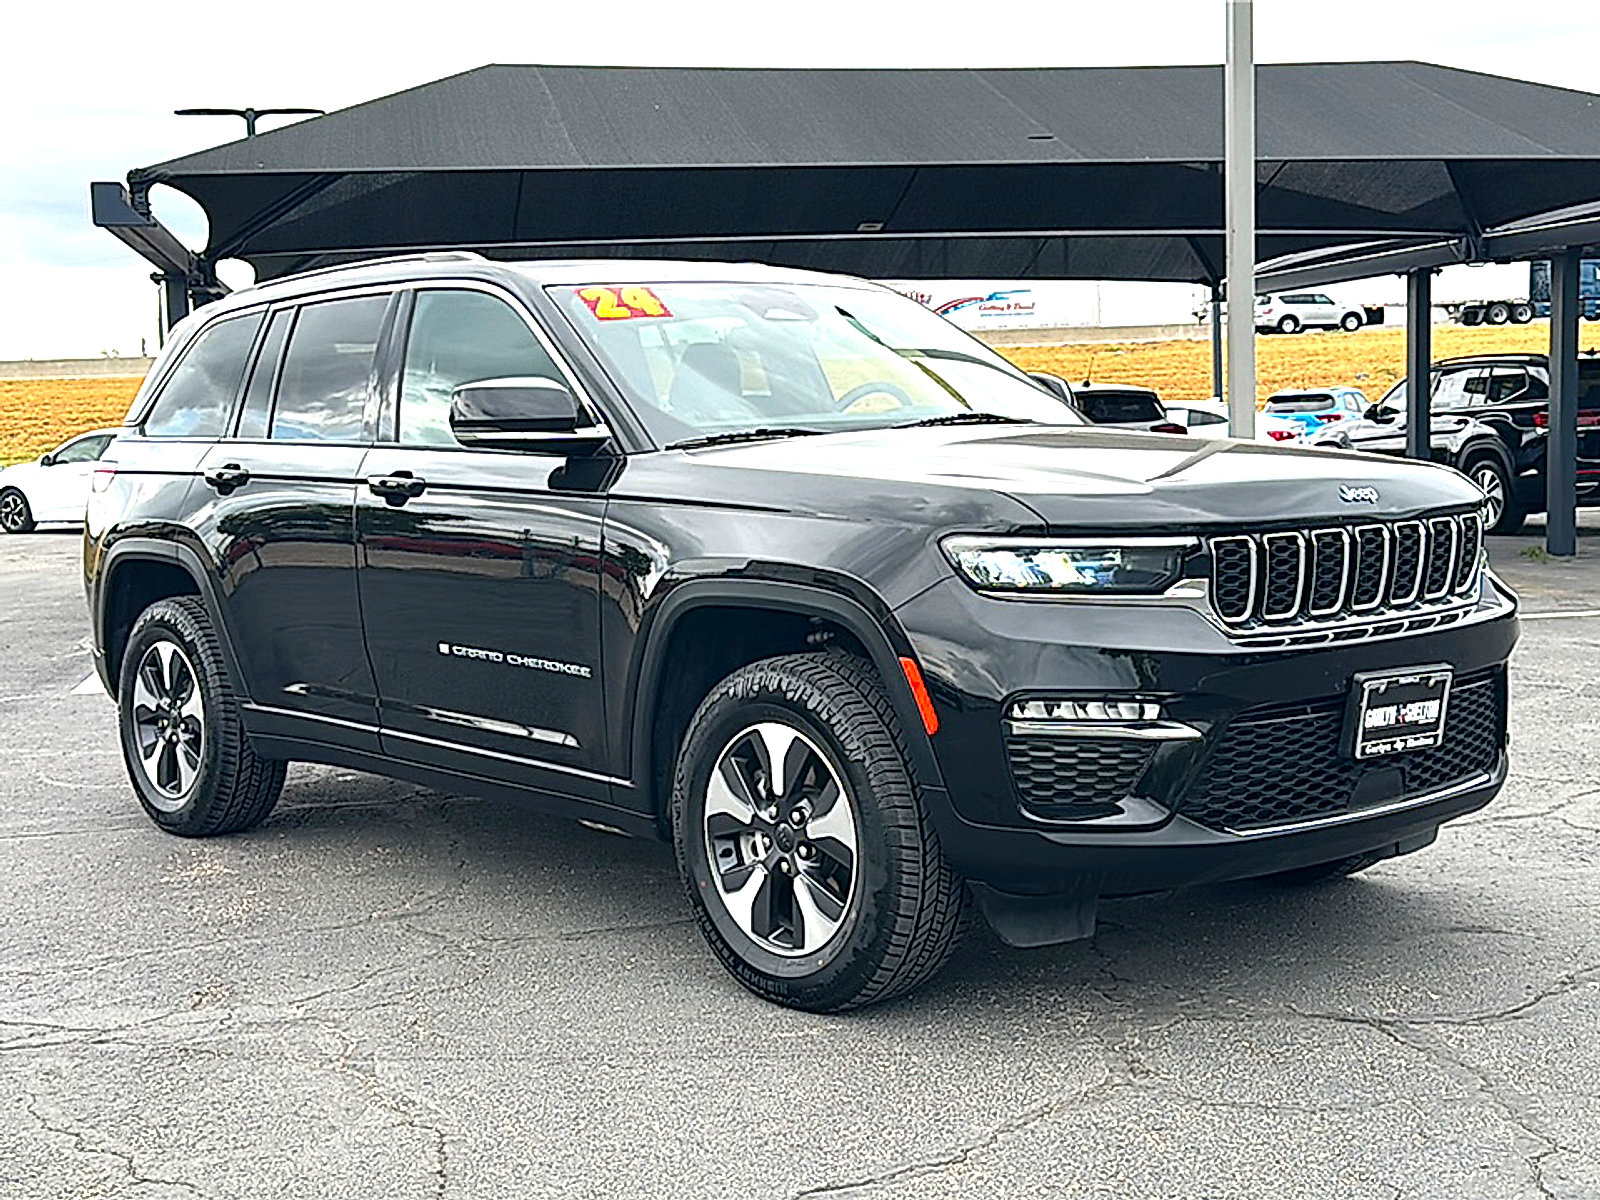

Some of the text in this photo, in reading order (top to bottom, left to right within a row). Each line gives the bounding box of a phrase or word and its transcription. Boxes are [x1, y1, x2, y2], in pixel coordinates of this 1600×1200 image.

[579, 286, 667, 318] 24
[1339, 484, 1379, 504] Jeep
[452, 645, 592, 678] GRAND CHEROKEE
